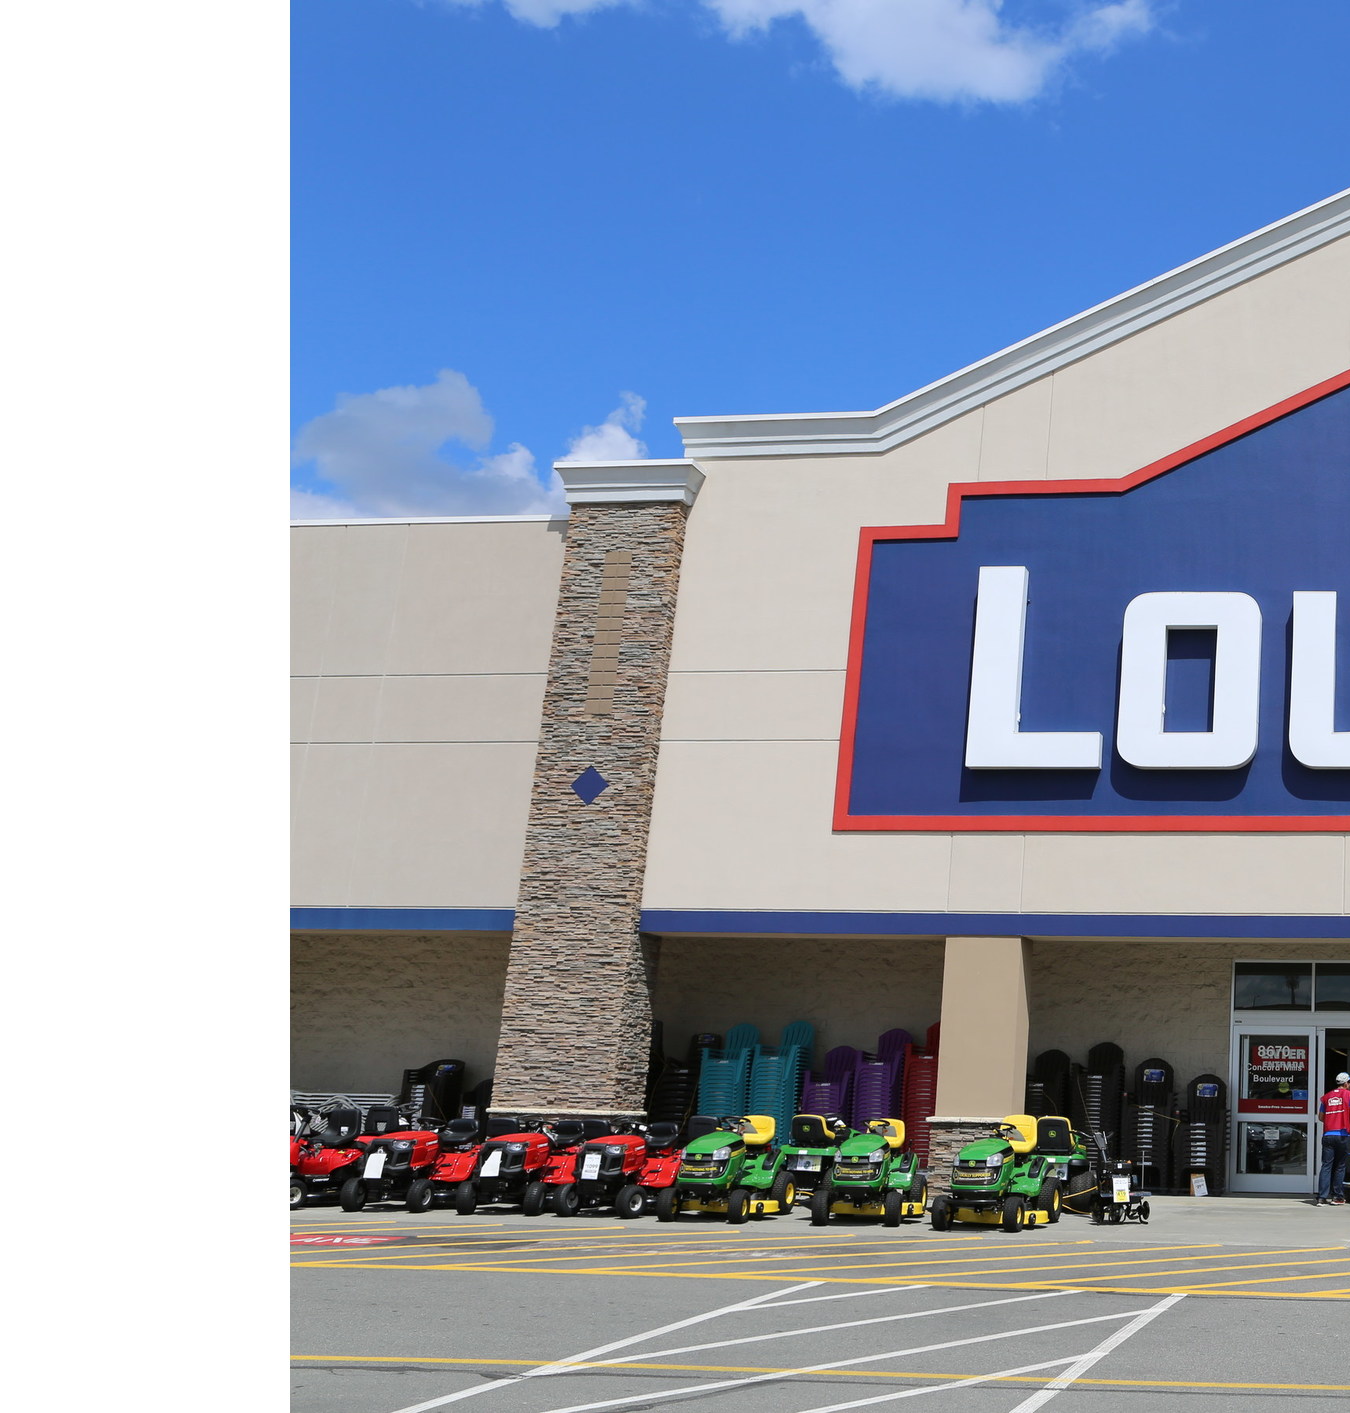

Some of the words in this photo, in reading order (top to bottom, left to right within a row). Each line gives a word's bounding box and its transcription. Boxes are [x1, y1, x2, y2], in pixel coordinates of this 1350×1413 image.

[1257, 1045, 1290, 1057] 8670
[1246, 1062, 1280, 1071] Concord
[1253, 1074, 1294, 1083] Boulevard
